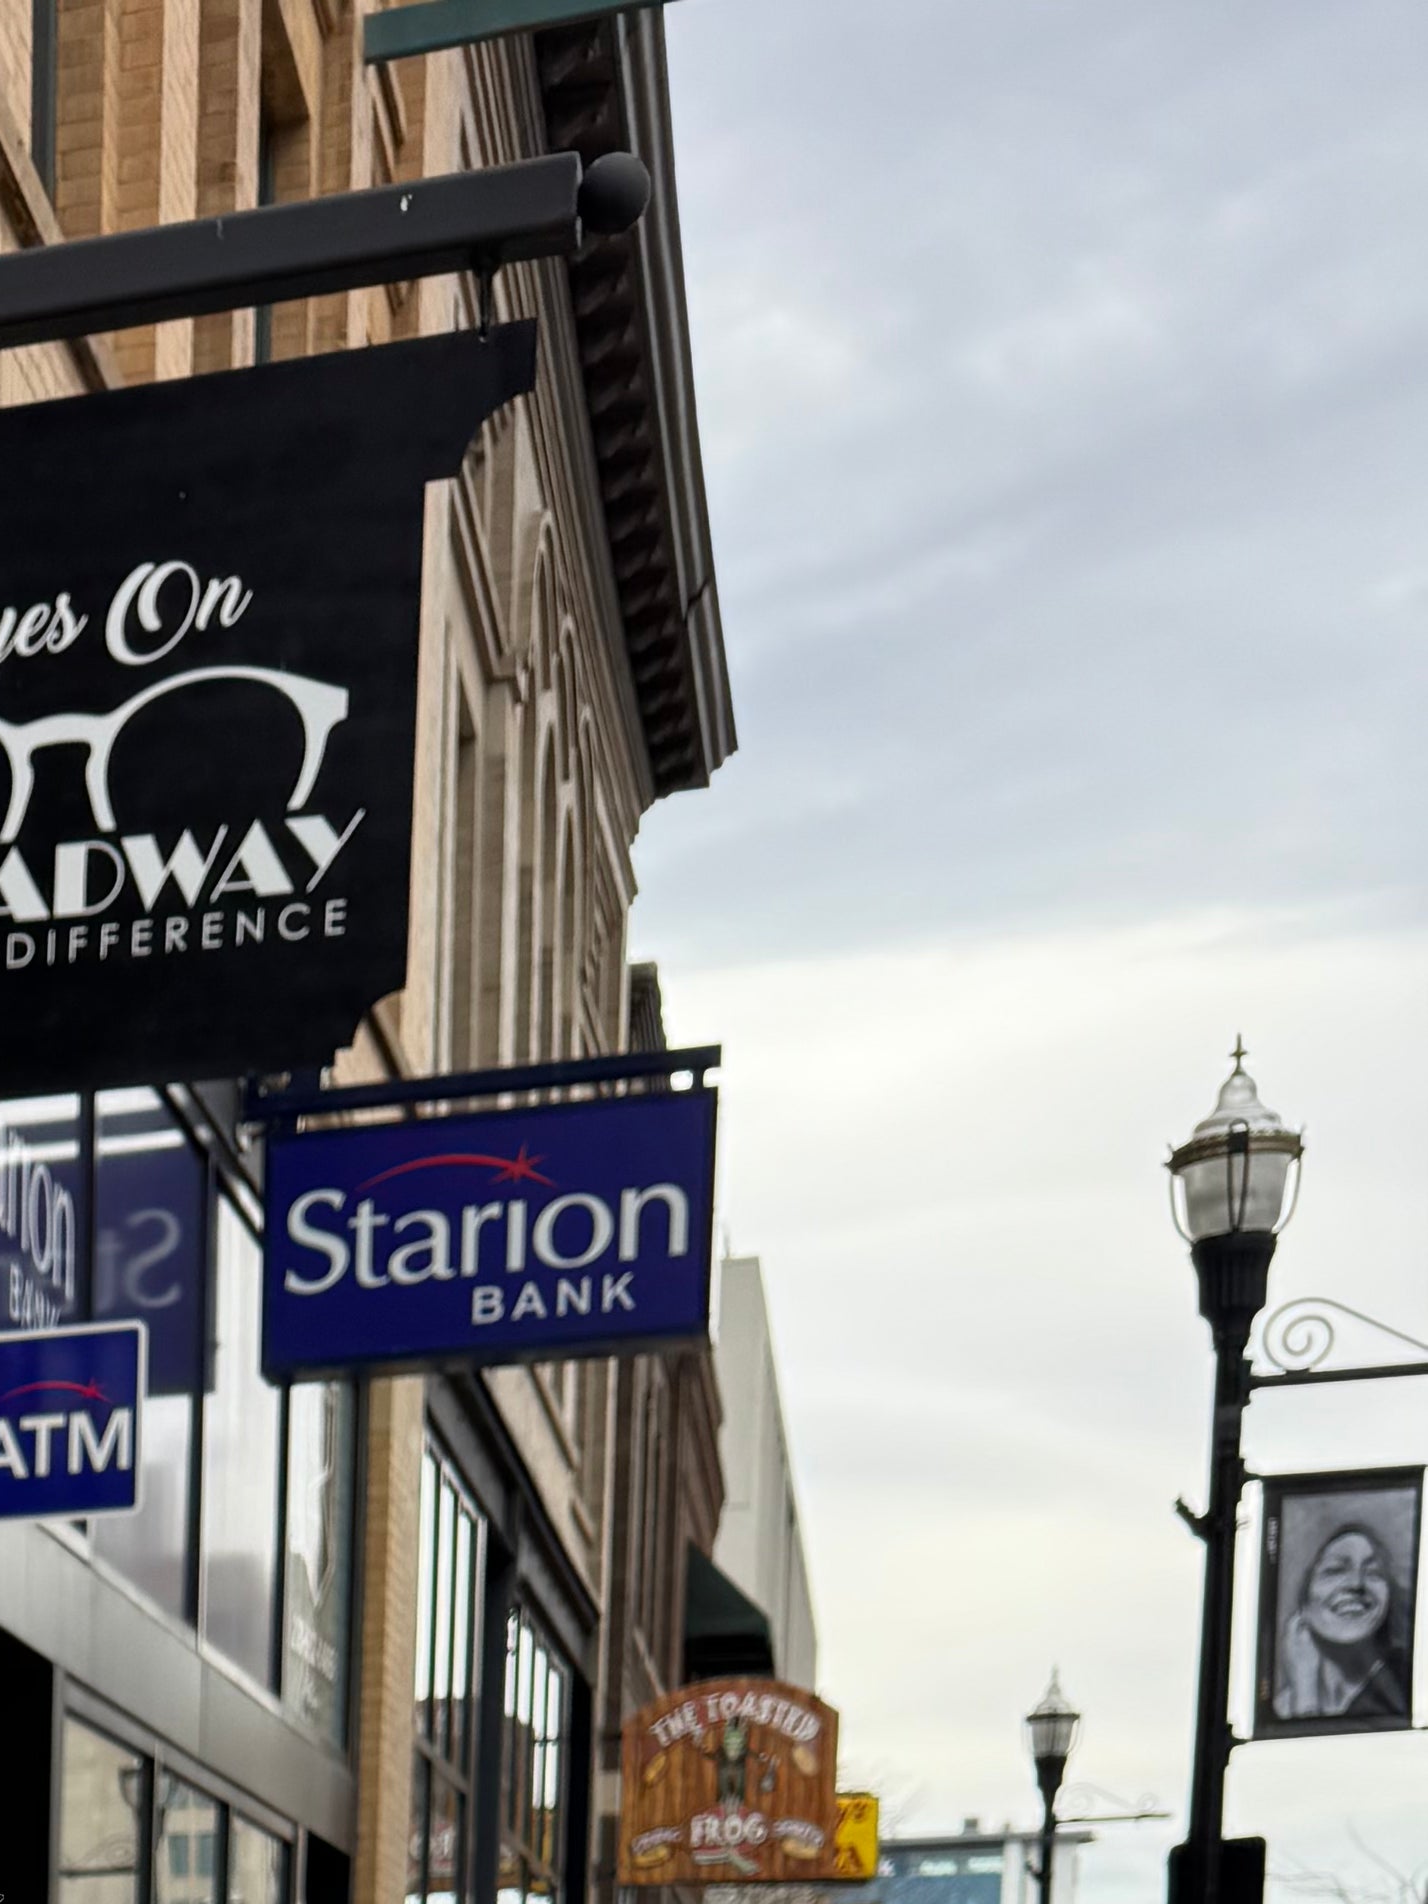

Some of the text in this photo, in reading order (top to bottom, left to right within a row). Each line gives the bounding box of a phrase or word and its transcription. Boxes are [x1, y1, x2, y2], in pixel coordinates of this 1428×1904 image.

[104, 560, 253, 667] On
[5, 898, 348, 970] DIFFERENCE
[283, 1183, 689, 1295] Starion
[471, 1272, 635, 1325] BANK
[649, 1701, 702, 1748] THE
[690, 1812, 769, 1848] FROG
